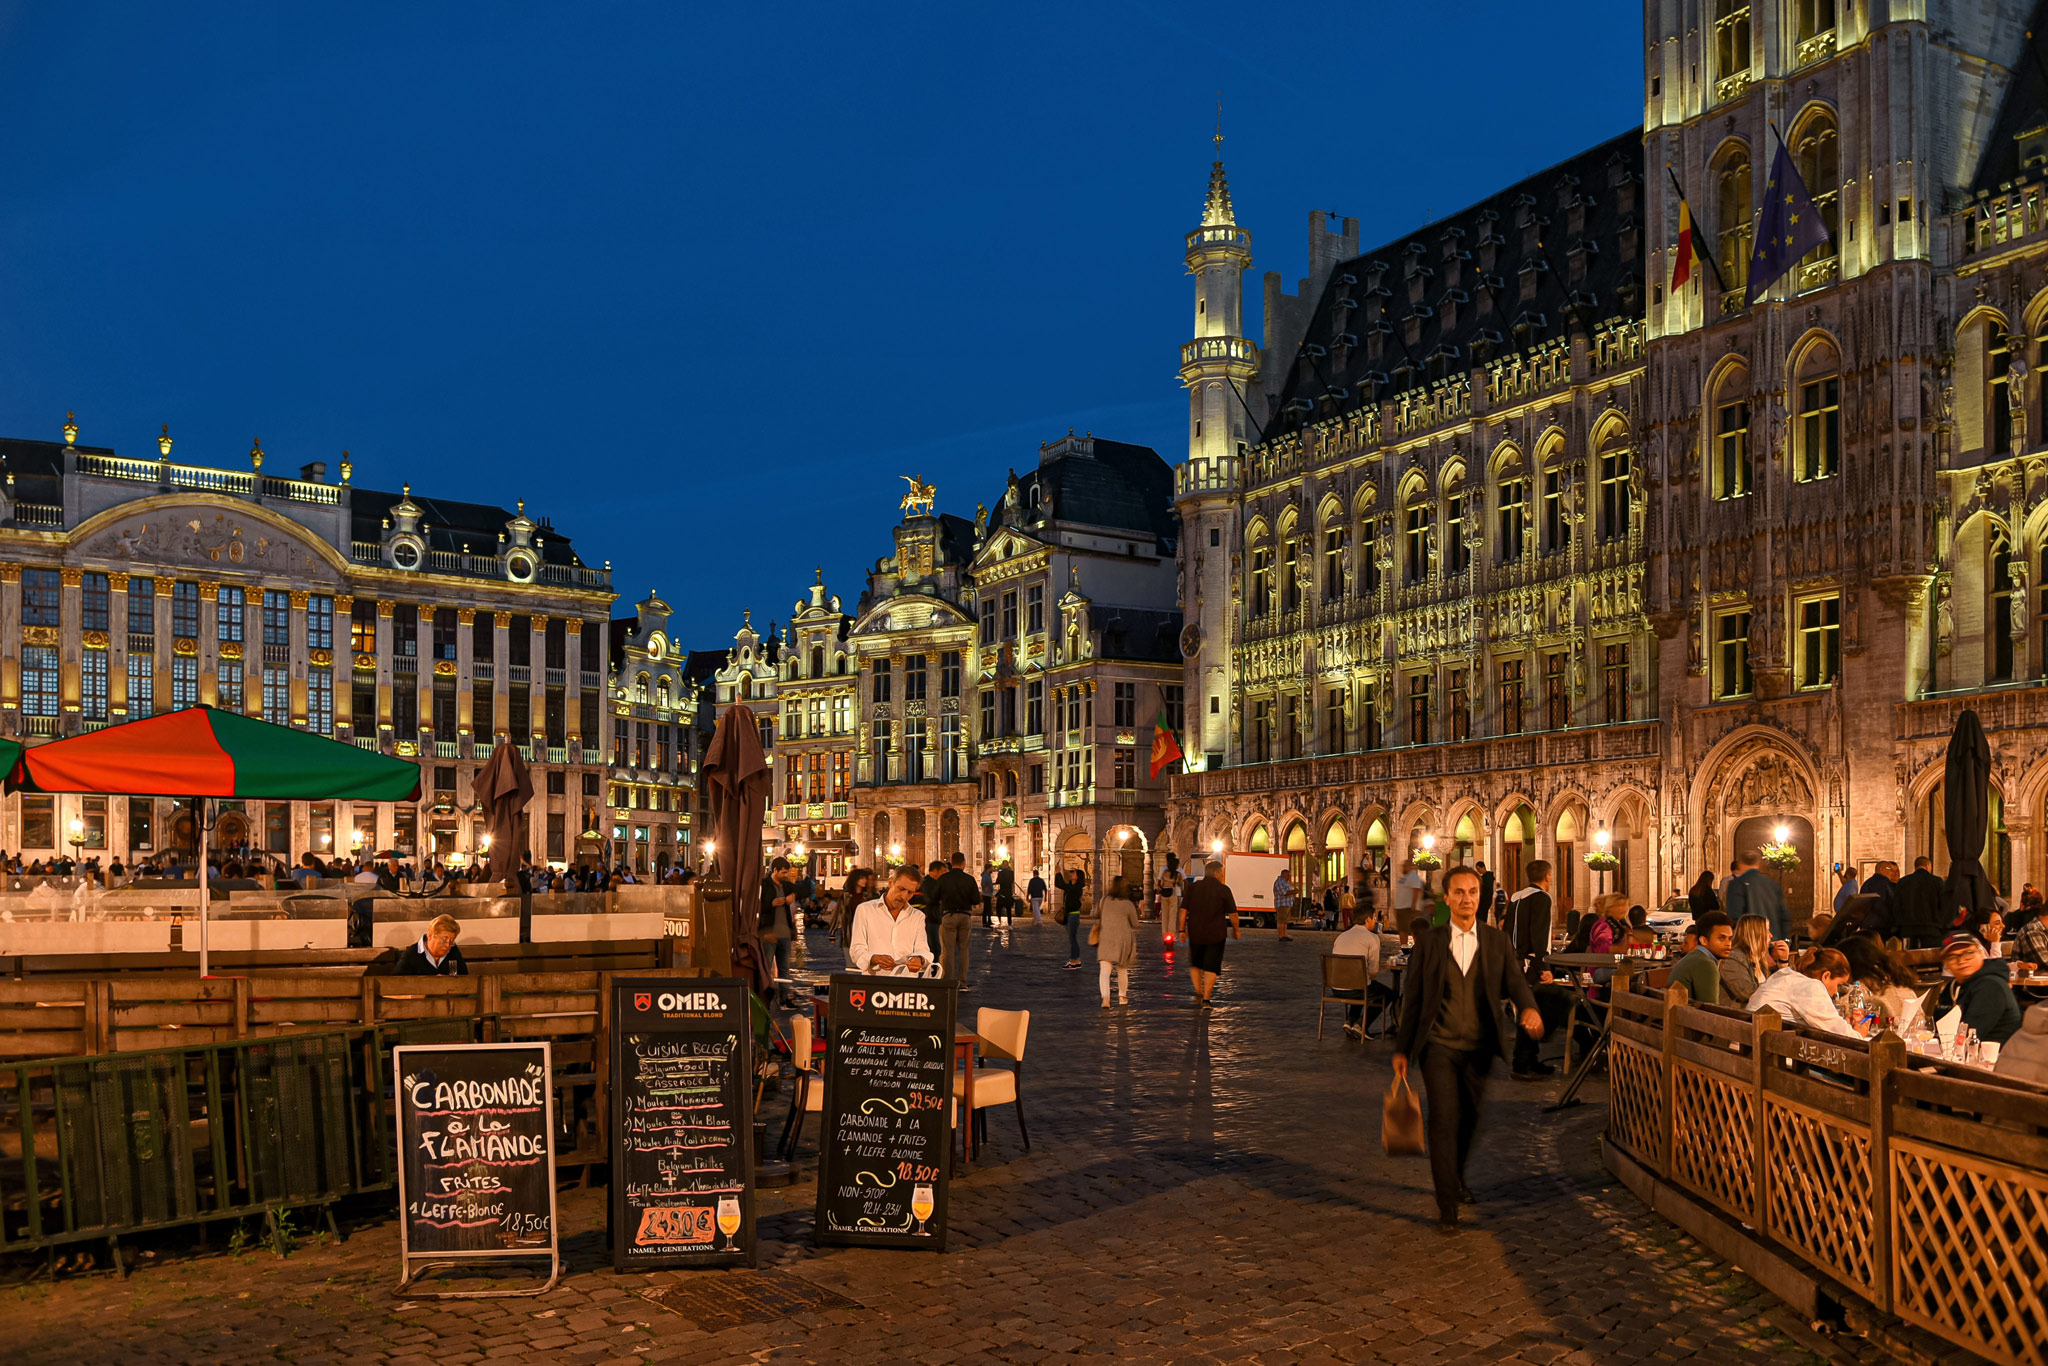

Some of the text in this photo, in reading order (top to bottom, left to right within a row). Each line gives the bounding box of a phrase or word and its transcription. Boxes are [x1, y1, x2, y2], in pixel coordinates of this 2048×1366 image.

[664, 920, 690, 937] FOOD
[411, 1077, 544, 1110] CARBONADE
[840, 1113, 888, 1128] CARBONADE
[909, 1119, 920, 1129] LA
[837, 1130, 883, 1143] FLAMANDE
[419, 1131, 547, 1161] FLAMANDE
[891, 1149, 923, 1160] BLONDE
[500, 1212, 550, 1237] 18,50€
